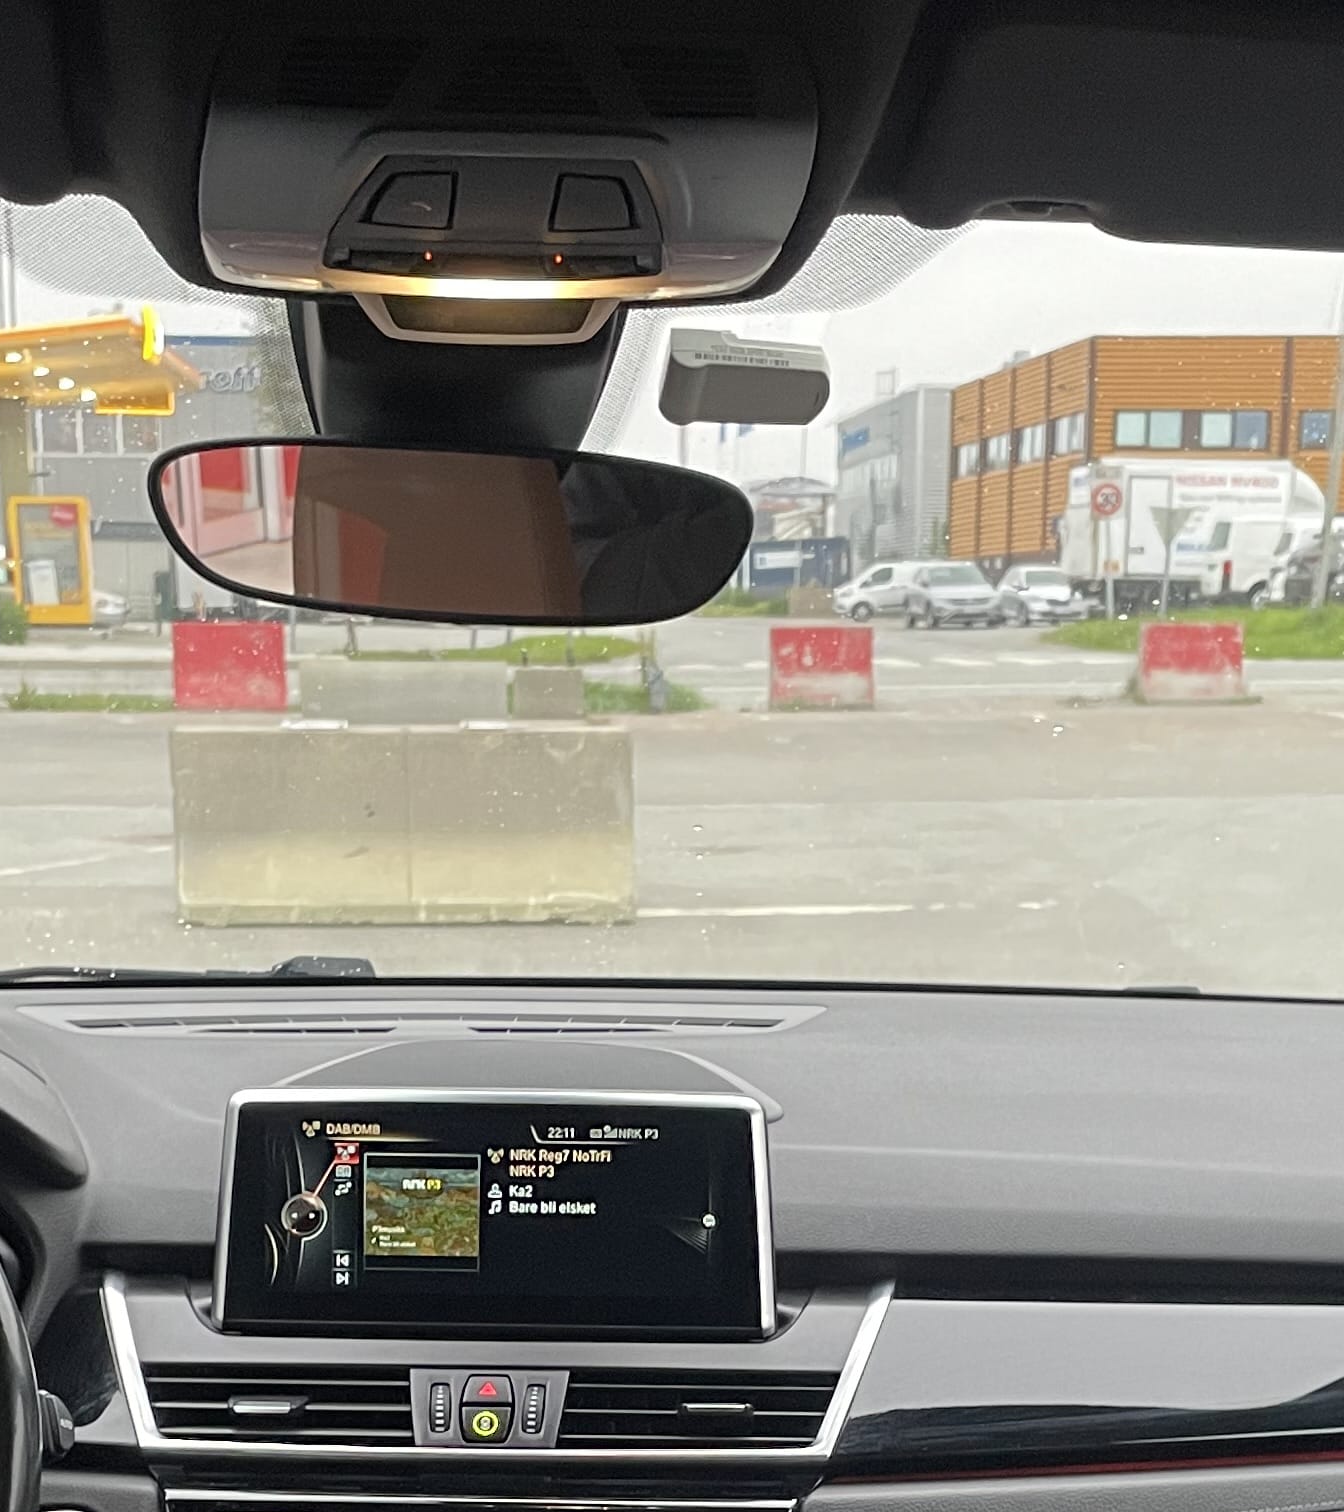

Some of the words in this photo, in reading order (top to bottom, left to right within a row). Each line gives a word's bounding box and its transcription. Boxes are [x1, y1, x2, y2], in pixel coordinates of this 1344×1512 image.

[326, 1123, 381, 1135] DAB/DMB
[618, 1128, 643, 1139] NRK
[644, 1128, 659, 1140] P3
[509, 1149, 536, 1161] NRK
[538, 1149, 570, 1165] Reg7
[509, 1165, 536, 1177] NRK
[538, 1165, 555, 1178] P3
[508, 1185, 533, 1198] Ka2
[508, 1201, 538, 1214] Bare
[540, 1201, 557, 1214] bli
[558, 1201, 597, 1215] elsket
